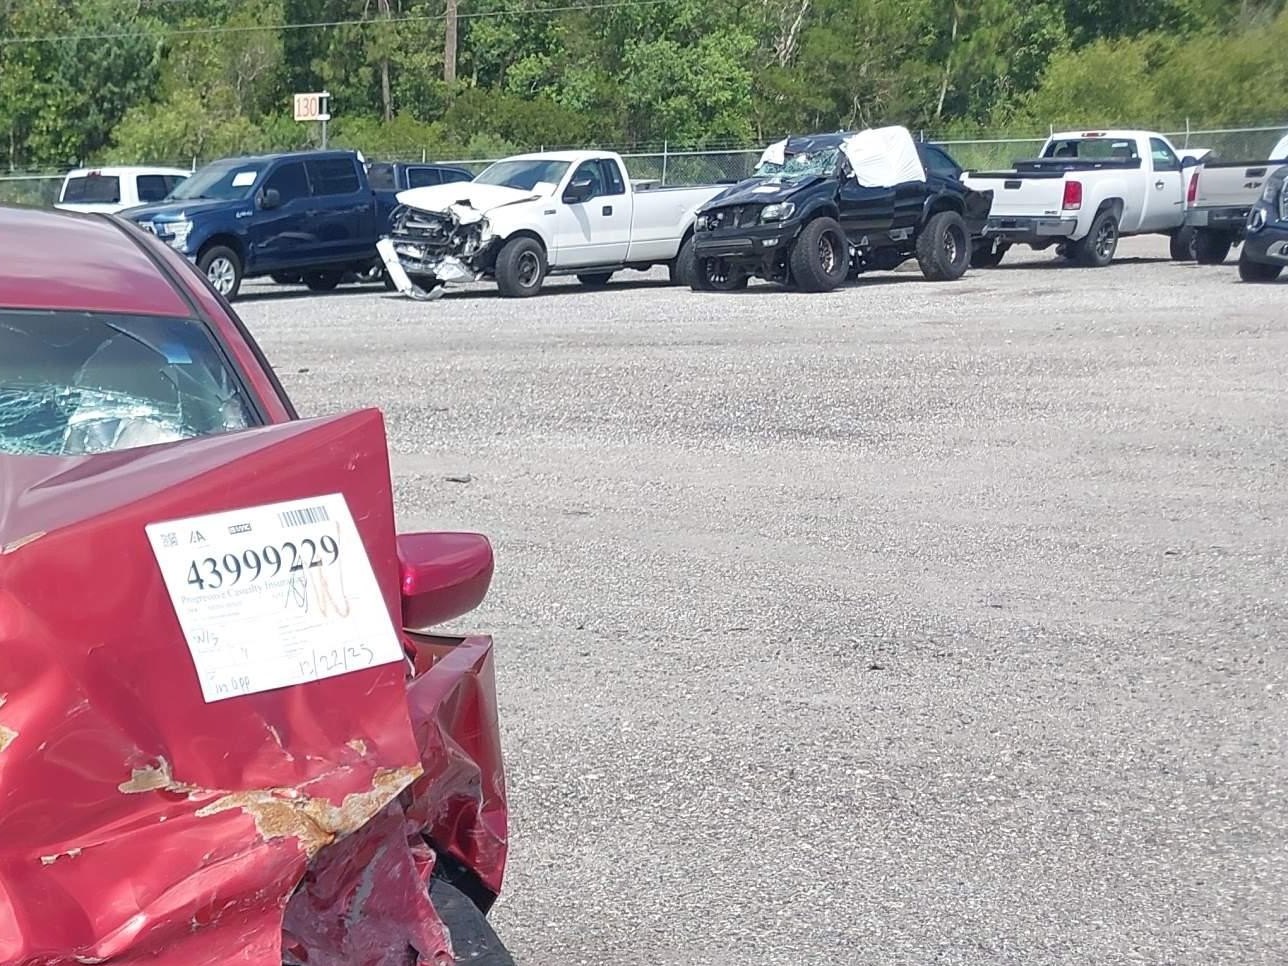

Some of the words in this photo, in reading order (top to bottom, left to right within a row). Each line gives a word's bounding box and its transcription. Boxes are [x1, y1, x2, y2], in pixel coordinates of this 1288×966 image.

[296, 97, 317, 117] 130
[187, 534, 340, 591] 43999229
[227, 583, 262, 599] Casualty
